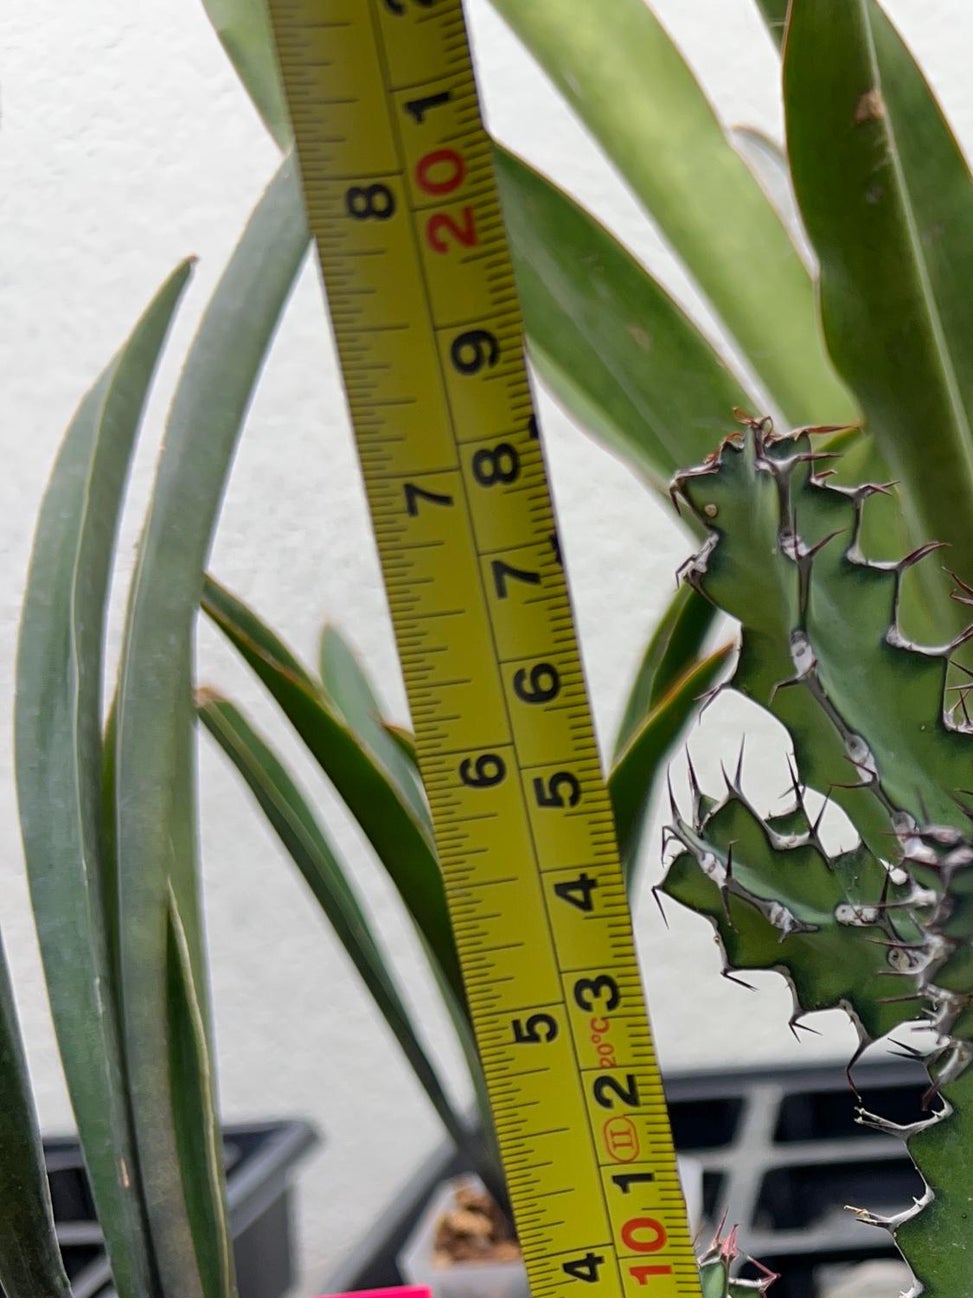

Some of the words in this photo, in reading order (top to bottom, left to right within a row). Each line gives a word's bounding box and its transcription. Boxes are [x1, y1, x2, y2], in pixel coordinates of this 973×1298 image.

[405, 91, 452, 122] 1
[348, 184, 395, 219] 8
[416, 149, 476, 252] 20
[451, 329, 499, 374] 9
[473, 443, 520, 486] 8
[404, 484, 452, 516] 7
[492, 561, 541, 597] 7
[514, 663, 560, 703] 6
[460, 755, 505, 787] 6
[534, 772, 582, 807] 5
[554, 872, 598, 912] 4
[575, 975, 620, 1011] 3
[512, 1014, 556, 1042] 5
[590, 1019, 615, 1066] 20°C
[594, 1075, 639, 1107] 2
[613, 1173, 652, 1192] 1
[563, 1253, 602, 1282] 4
[620, 1217, 672, 1286] 10
